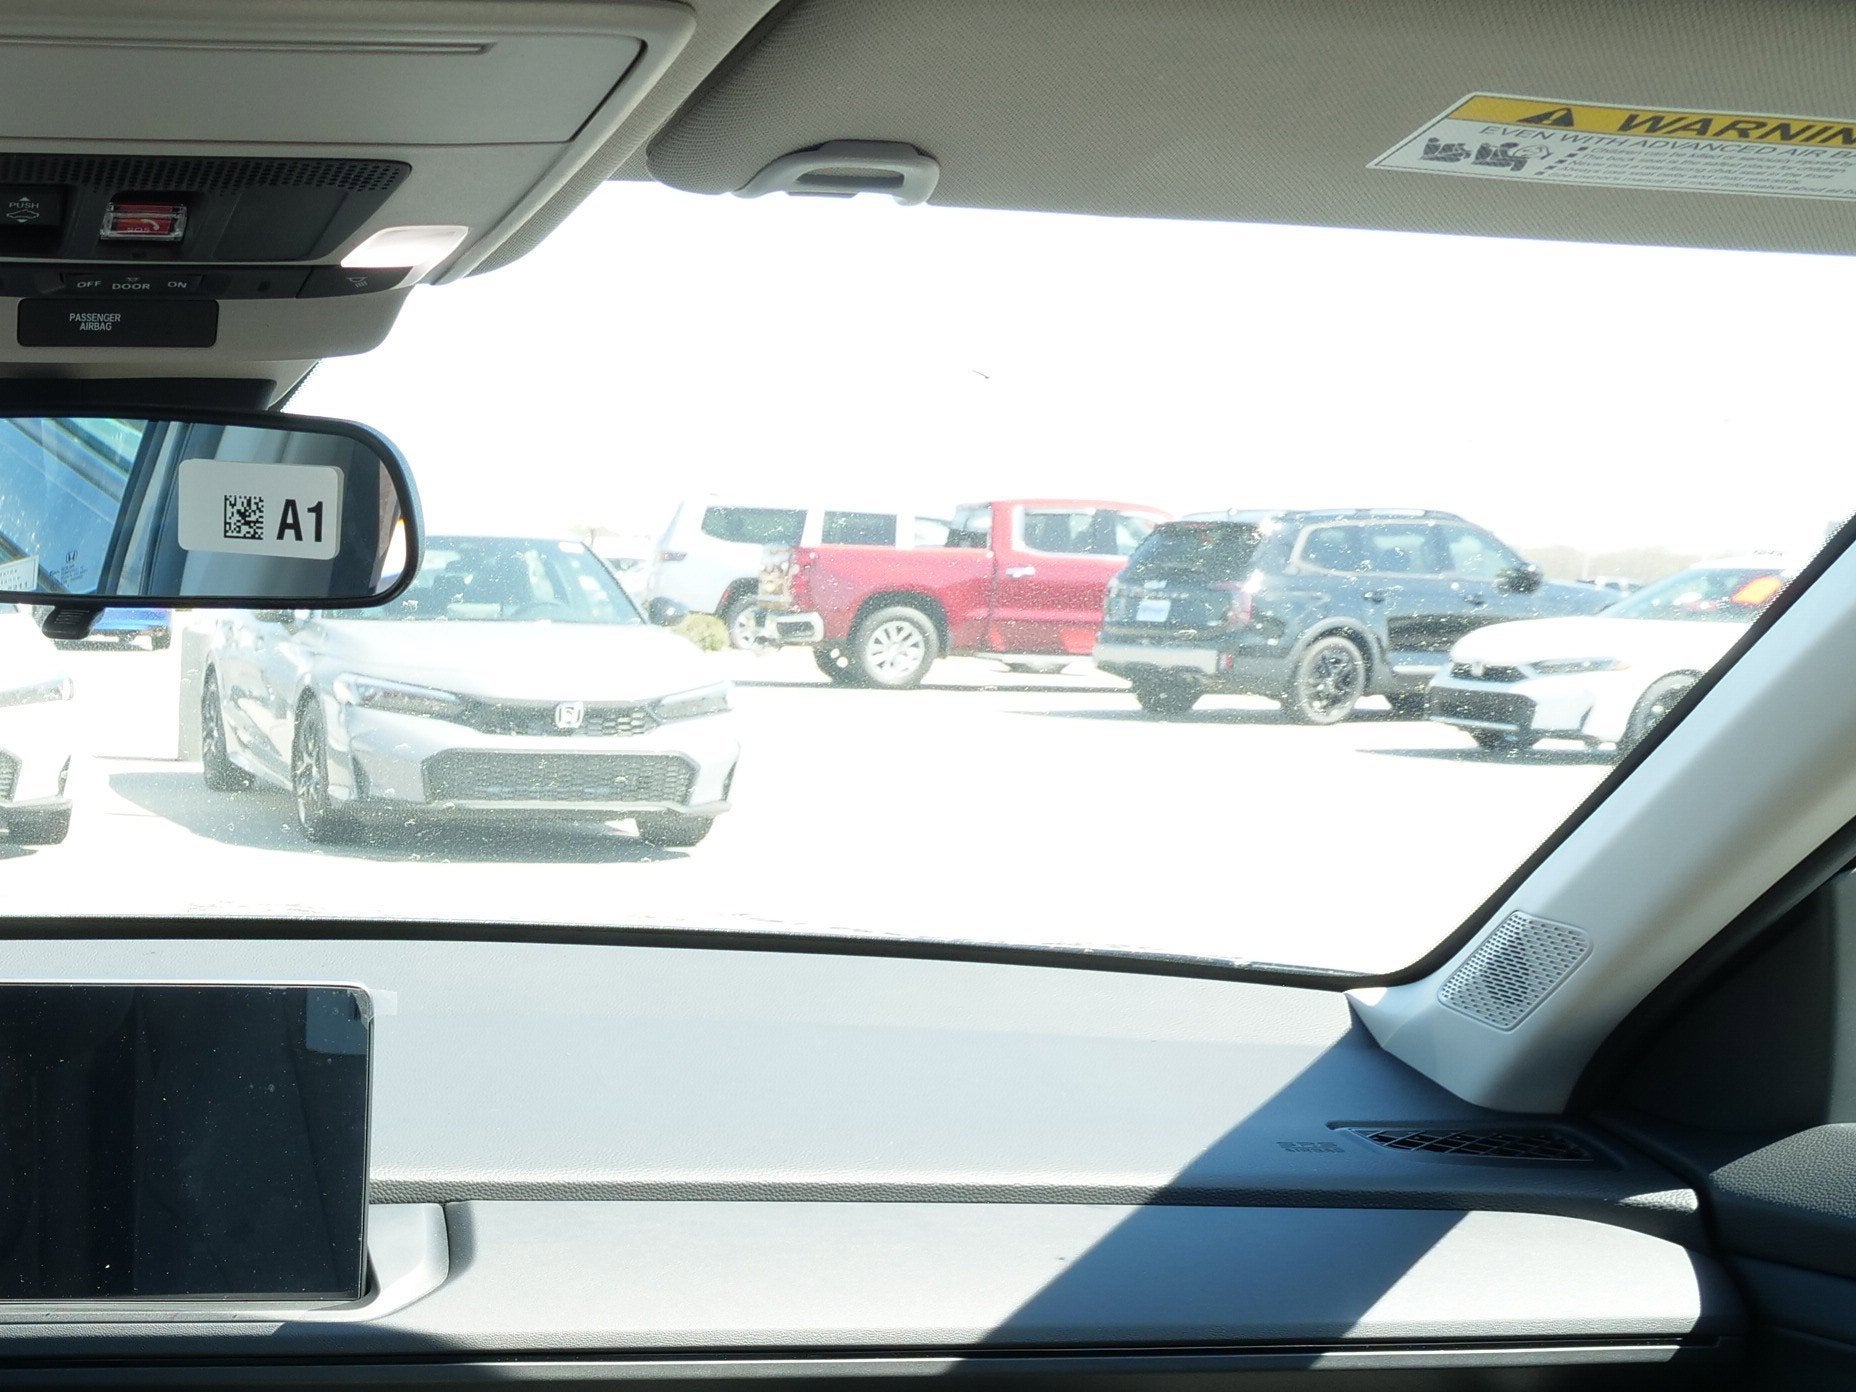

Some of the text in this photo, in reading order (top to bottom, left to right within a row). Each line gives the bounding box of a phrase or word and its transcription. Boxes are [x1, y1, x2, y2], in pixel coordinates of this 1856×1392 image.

[1479, 125, 1554, 141] EVEN
[1561, 133, 1628, 148] WITH
[1629, 139, 1777, 157] ADVANCED
[1777, 147, 1828, 158] AIR
[168, 281, 187, 289] ON
[70, 313, 121, 322] PASSENGER
[80, 322, 112, 331] AIRBAG
[277, 498, 323, 543] A1
